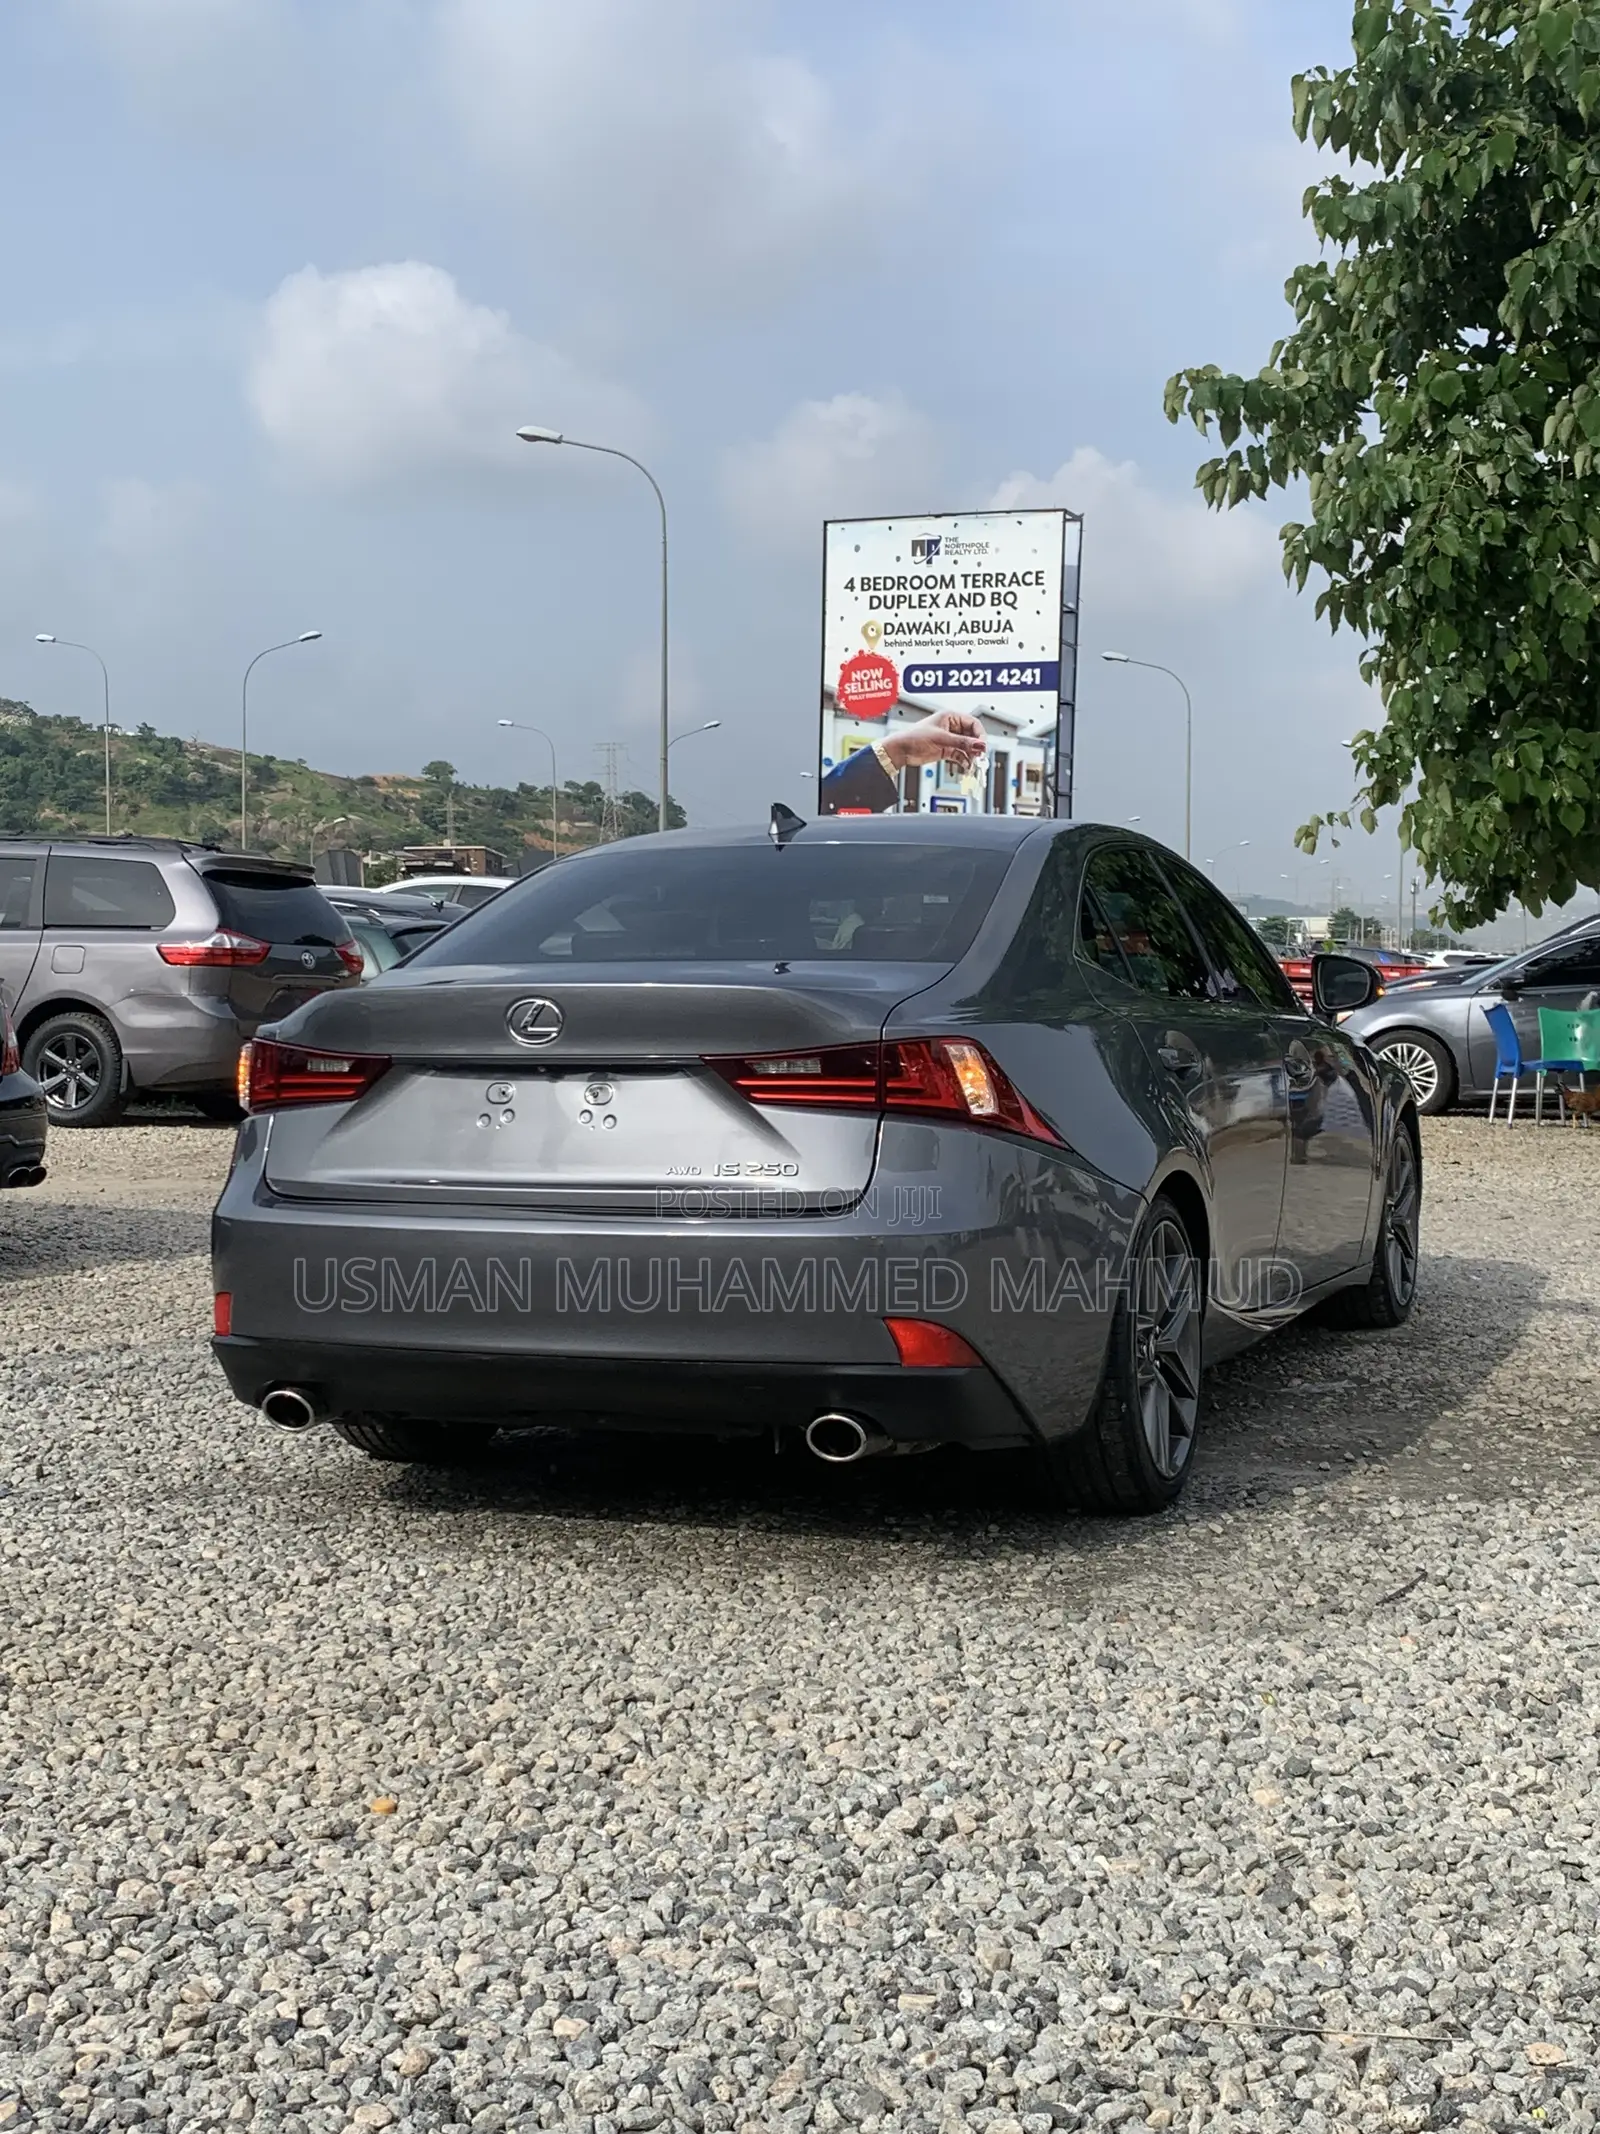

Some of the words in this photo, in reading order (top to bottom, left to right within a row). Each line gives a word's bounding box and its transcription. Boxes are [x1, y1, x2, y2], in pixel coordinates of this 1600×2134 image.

[844, 577, 856, 592] 4
[860, 574, 956, 592] BEDROOM
[961, 570, 1045, 589] TERRACE
[869, 593, 941, 610] DUPLEX
[945, 592, 986, 609] AND
[990, 591, 1018, 610] BQ
[883, 621, 951, 636] DAWAKI
[884, 638, 913, 648] behind
[914, 638, 944, 647] Market
[977, 637, 1009, 646] Dawaki
[851, 667, 884, 681] NOW
[910, 670, 943, 687] 091
[947, 669, 992, 687] 2021
[996, 668, 1041, 686] 4241
[844, 678, 893, 694] SELLING
[665, 1165, 702, 1176] AWD
[713, 1163, 740, 1177] IS
[744, 1162, 799, 1177] 250
